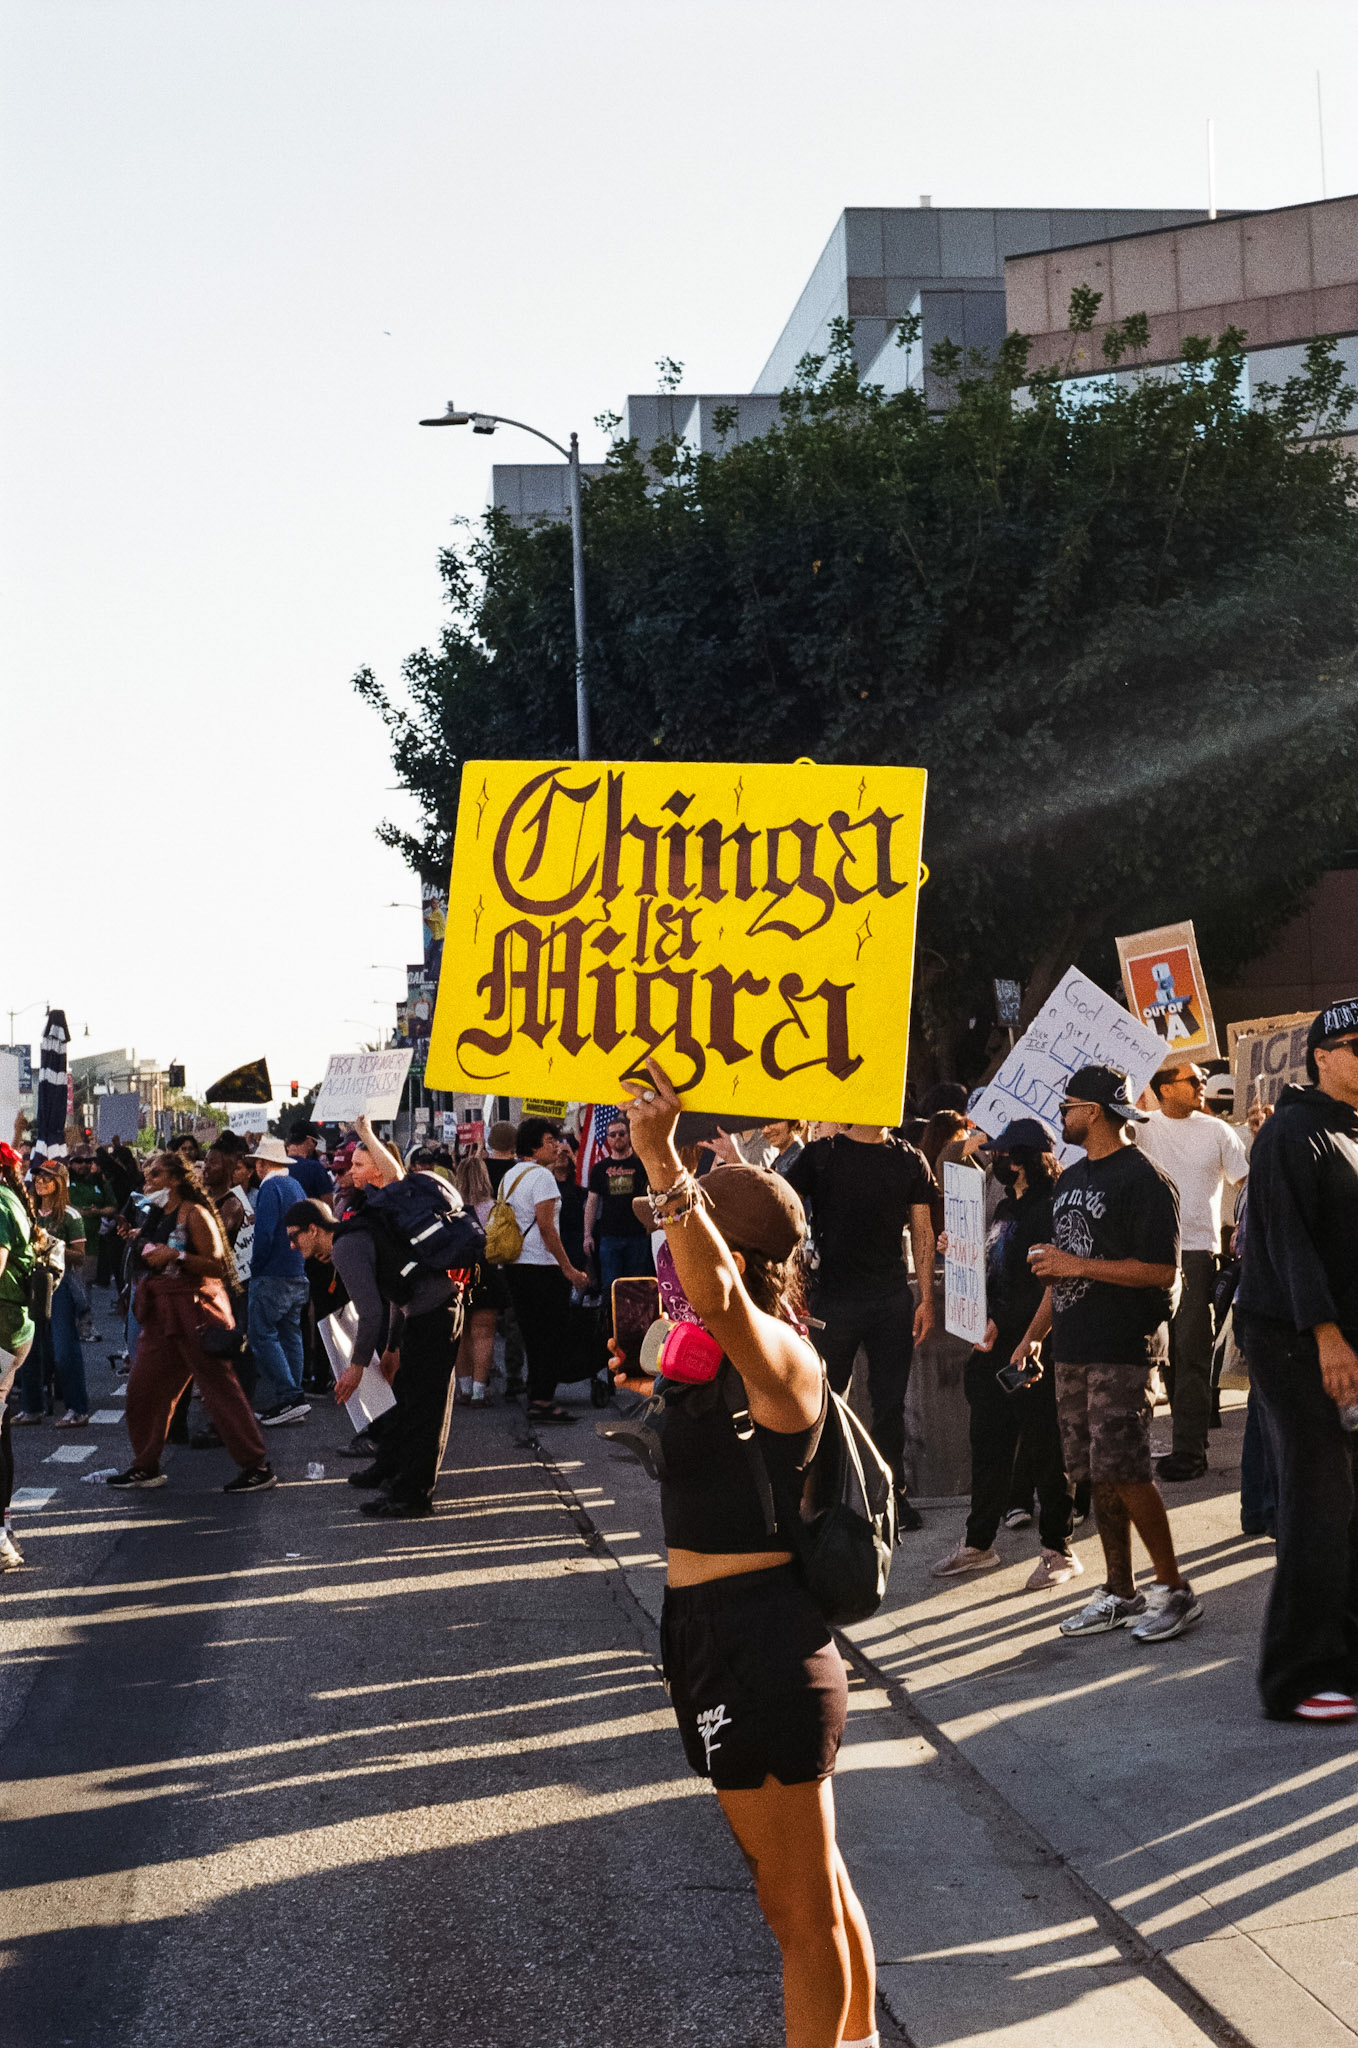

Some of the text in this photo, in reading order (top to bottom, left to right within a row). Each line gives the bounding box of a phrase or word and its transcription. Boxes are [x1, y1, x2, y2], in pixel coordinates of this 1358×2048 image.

[493, 767, 907, 940] Chinga
[631, 898, 702, 966] la
[456, 917, 864, 1094] Migra
[1065, 980, 1104, 1022] God
[1109, 1017, 1156, 1066] Forbid
[1065, 1022, 1089, 1046] girl
[1143, 1001, 1184, 1018] OUT OF
[327, 1057, 355, 1076] FIRST
[1250, 1025, 1312, 1080] ICE
